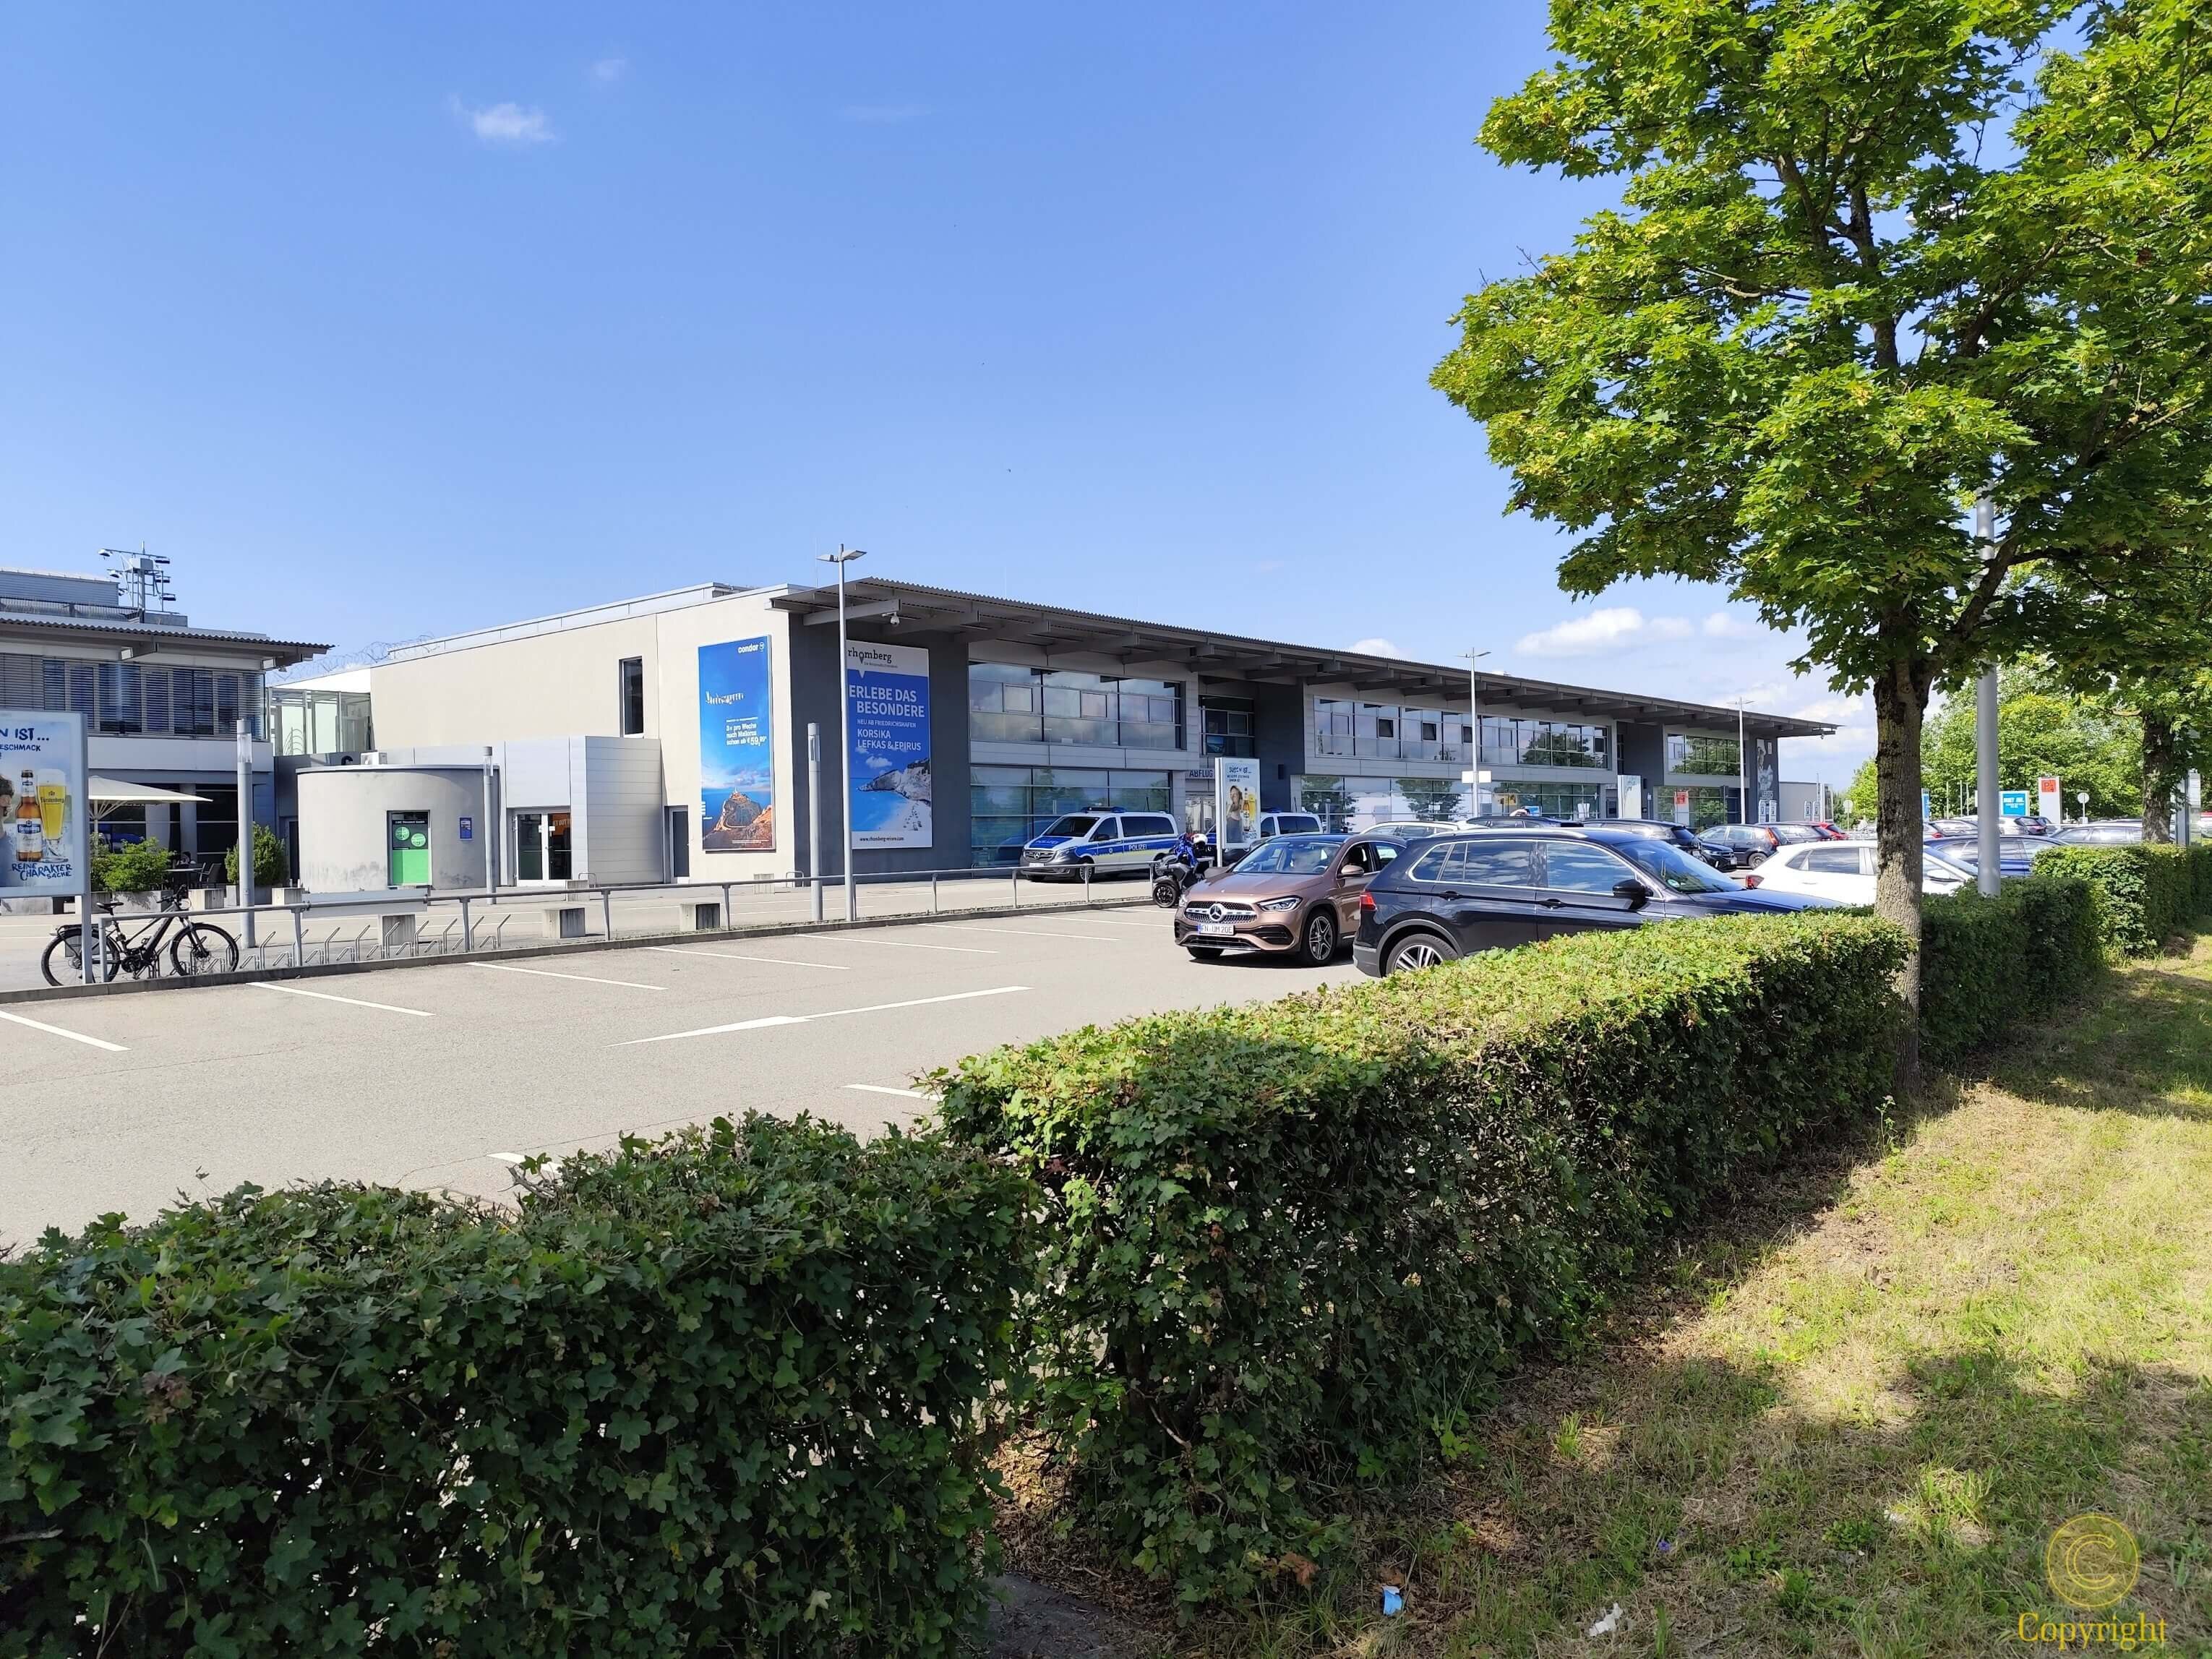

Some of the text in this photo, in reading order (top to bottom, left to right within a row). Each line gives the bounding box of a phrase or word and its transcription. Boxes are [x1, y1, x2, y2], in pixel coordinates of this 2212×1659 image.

[738, 643, 758, 653] condor
[847, 648, 892, 664] rhomberg
[849, 685, 917, 703] ERLEBE DAS
[857, 700, 925, 718] BESONDERE
[875, 720, 917, 729] FRIEDRICHSHAFEN
[857, 728, 891, 739] KORSIKA
[857, 739, 922, 751] LEFKAS & EPIRUS
[1189, 769, 1214, 779] ABFLUG
[12, 862, 38, 873] REINE
[20, 863, 73, 880] CHARAKTER
